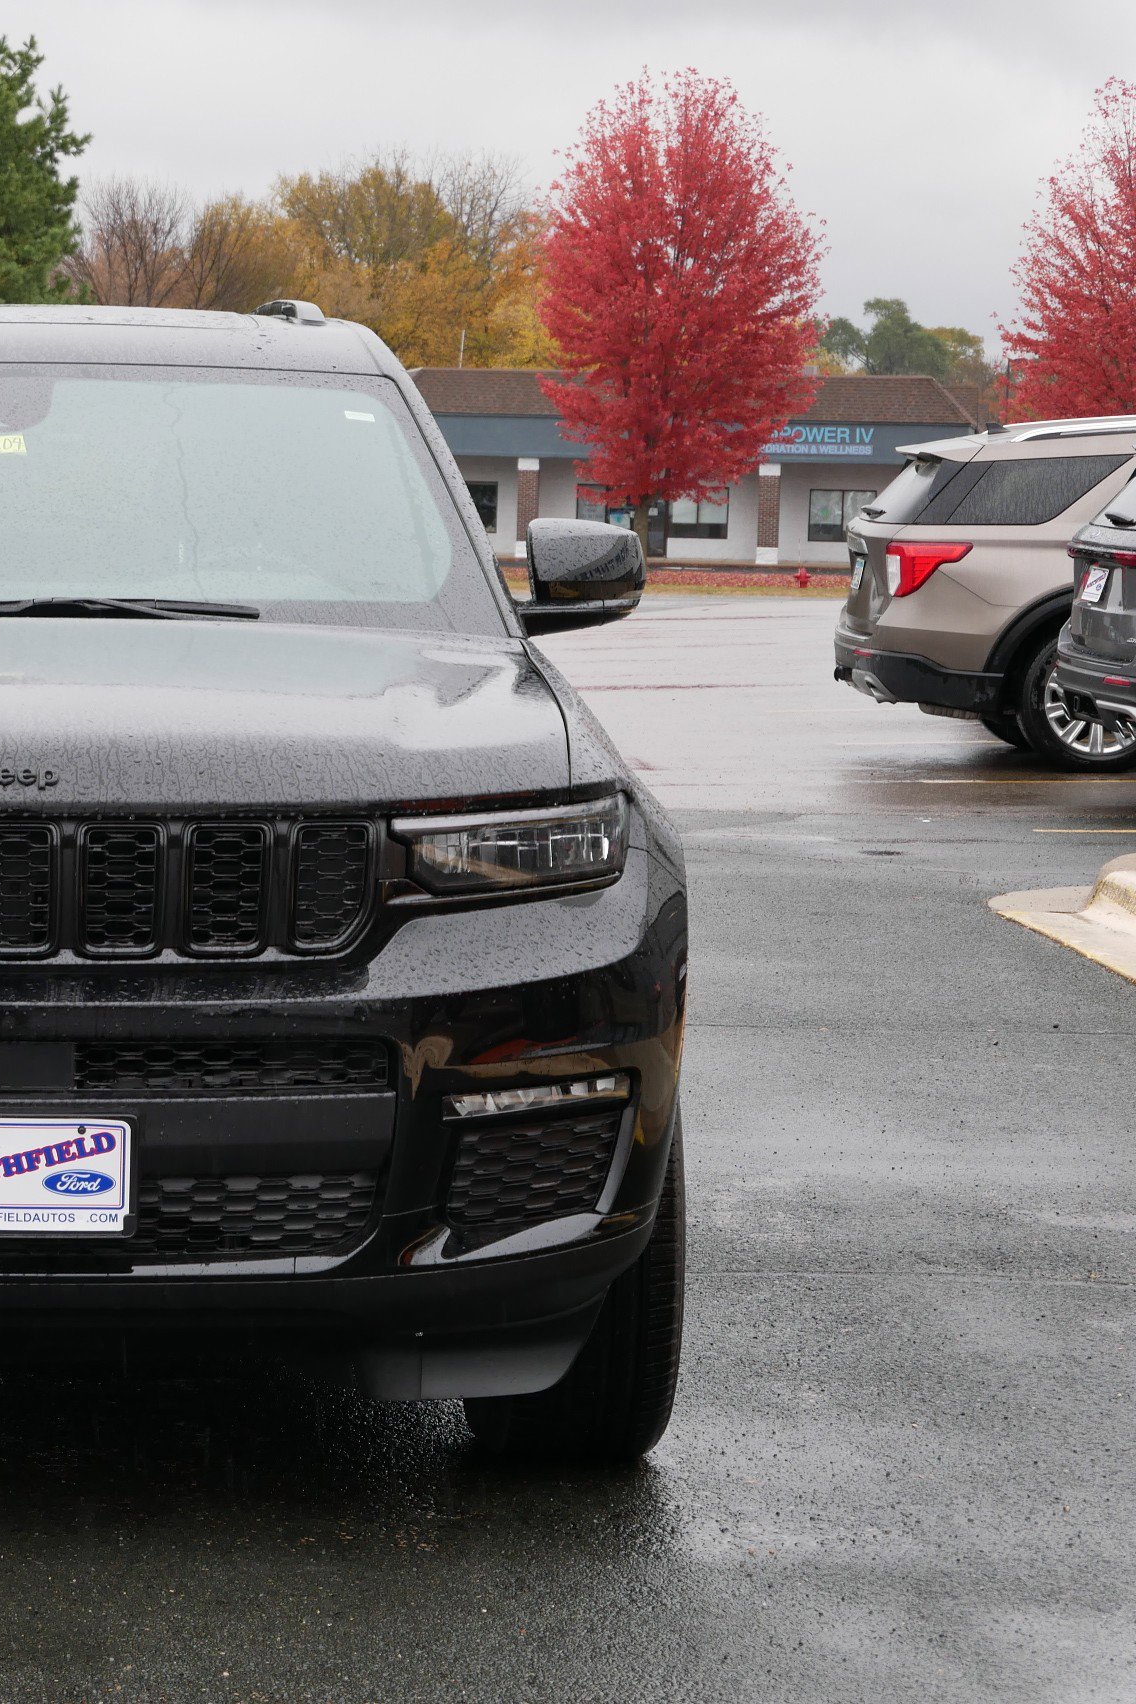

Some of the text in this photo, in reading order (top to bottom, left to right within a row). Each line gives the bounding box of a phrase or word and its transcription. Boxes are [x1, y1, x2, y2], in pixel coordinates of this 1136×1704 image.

[855, 427, 874, 443] IV
[810, 445, 817, 454] &
[819, 445, 872, 455] WELLNESS
[56, 1172, 100, 1191] Ford
[86, 1213, 119, 1223] .COM
